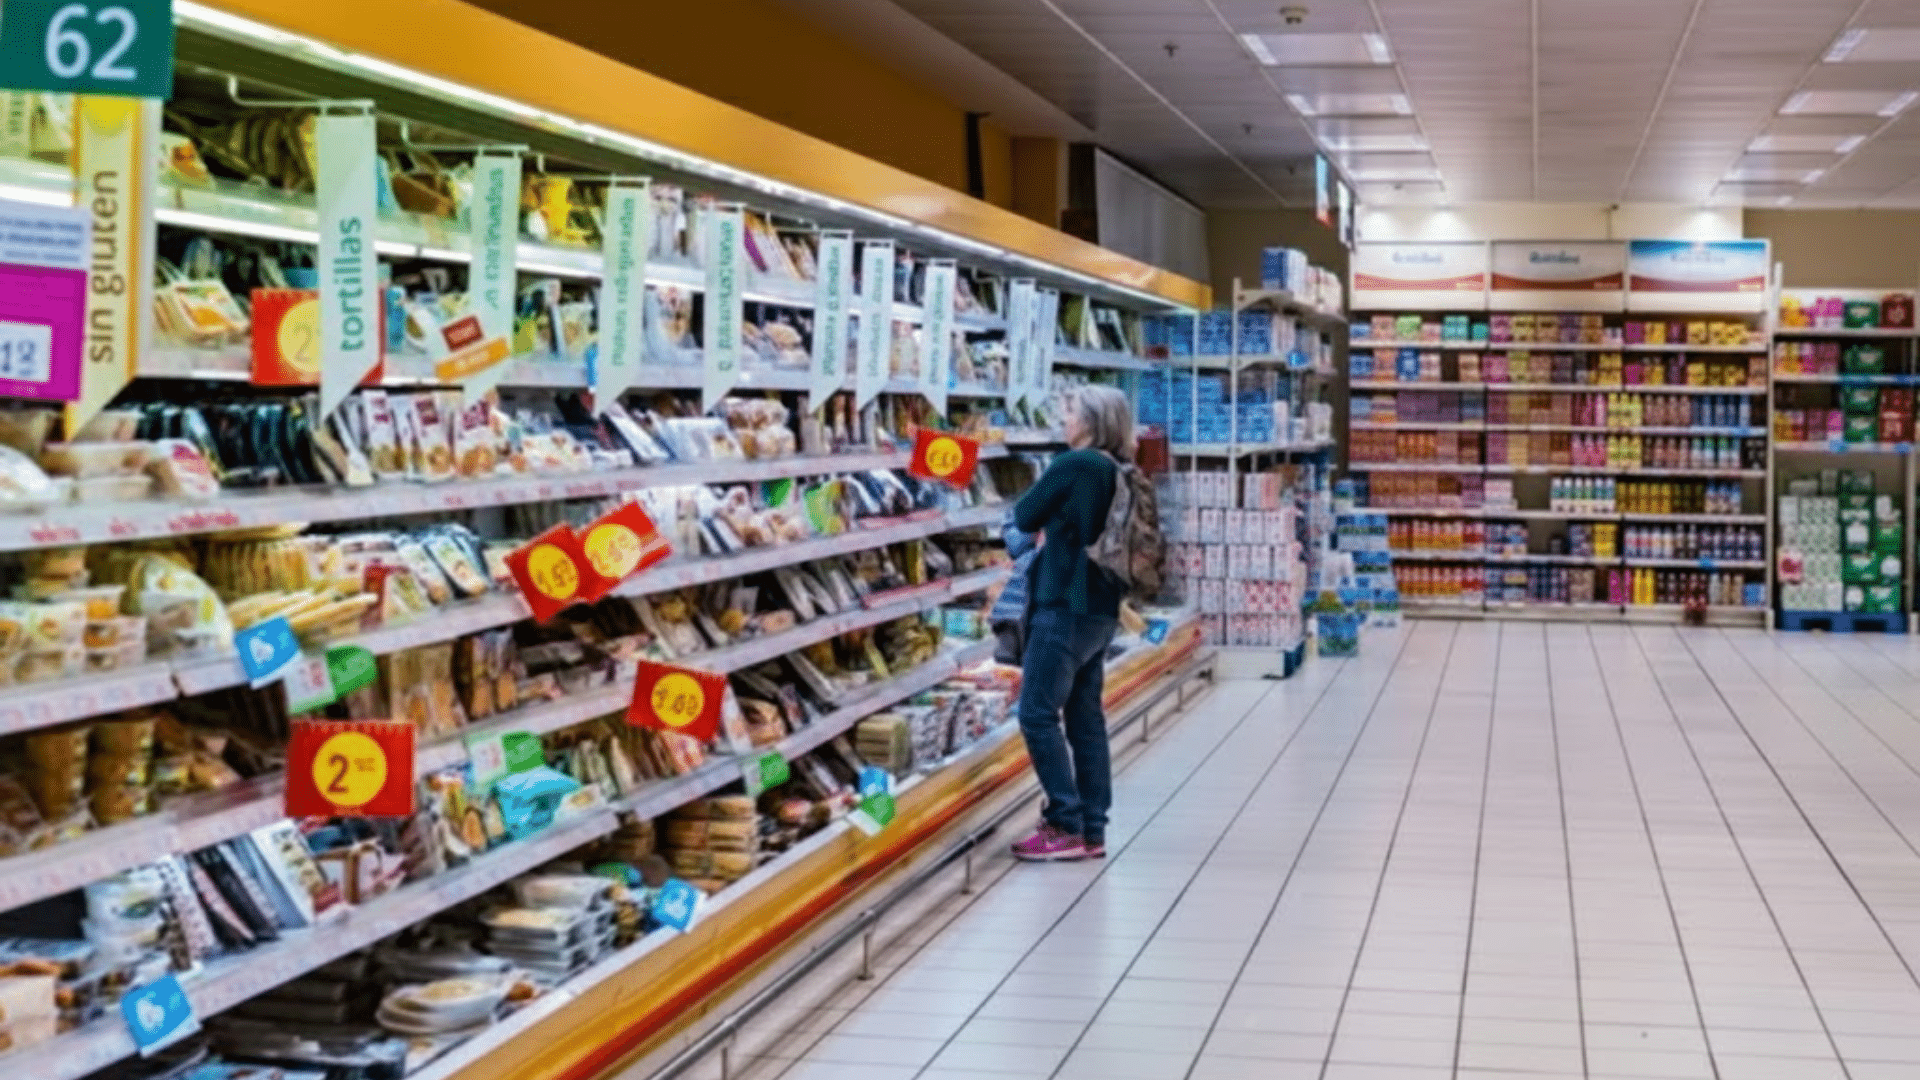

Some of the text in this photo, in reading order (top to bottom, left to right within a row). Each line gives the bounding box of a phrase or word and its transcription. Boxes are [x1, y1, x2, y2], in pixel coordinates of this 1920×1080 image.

[45, 4, 137, 80] 62
[90, 170, 125, 364] sin gluten
[338, 216, 364, 352] tortillas
[326, 752, 350, 794] 2
